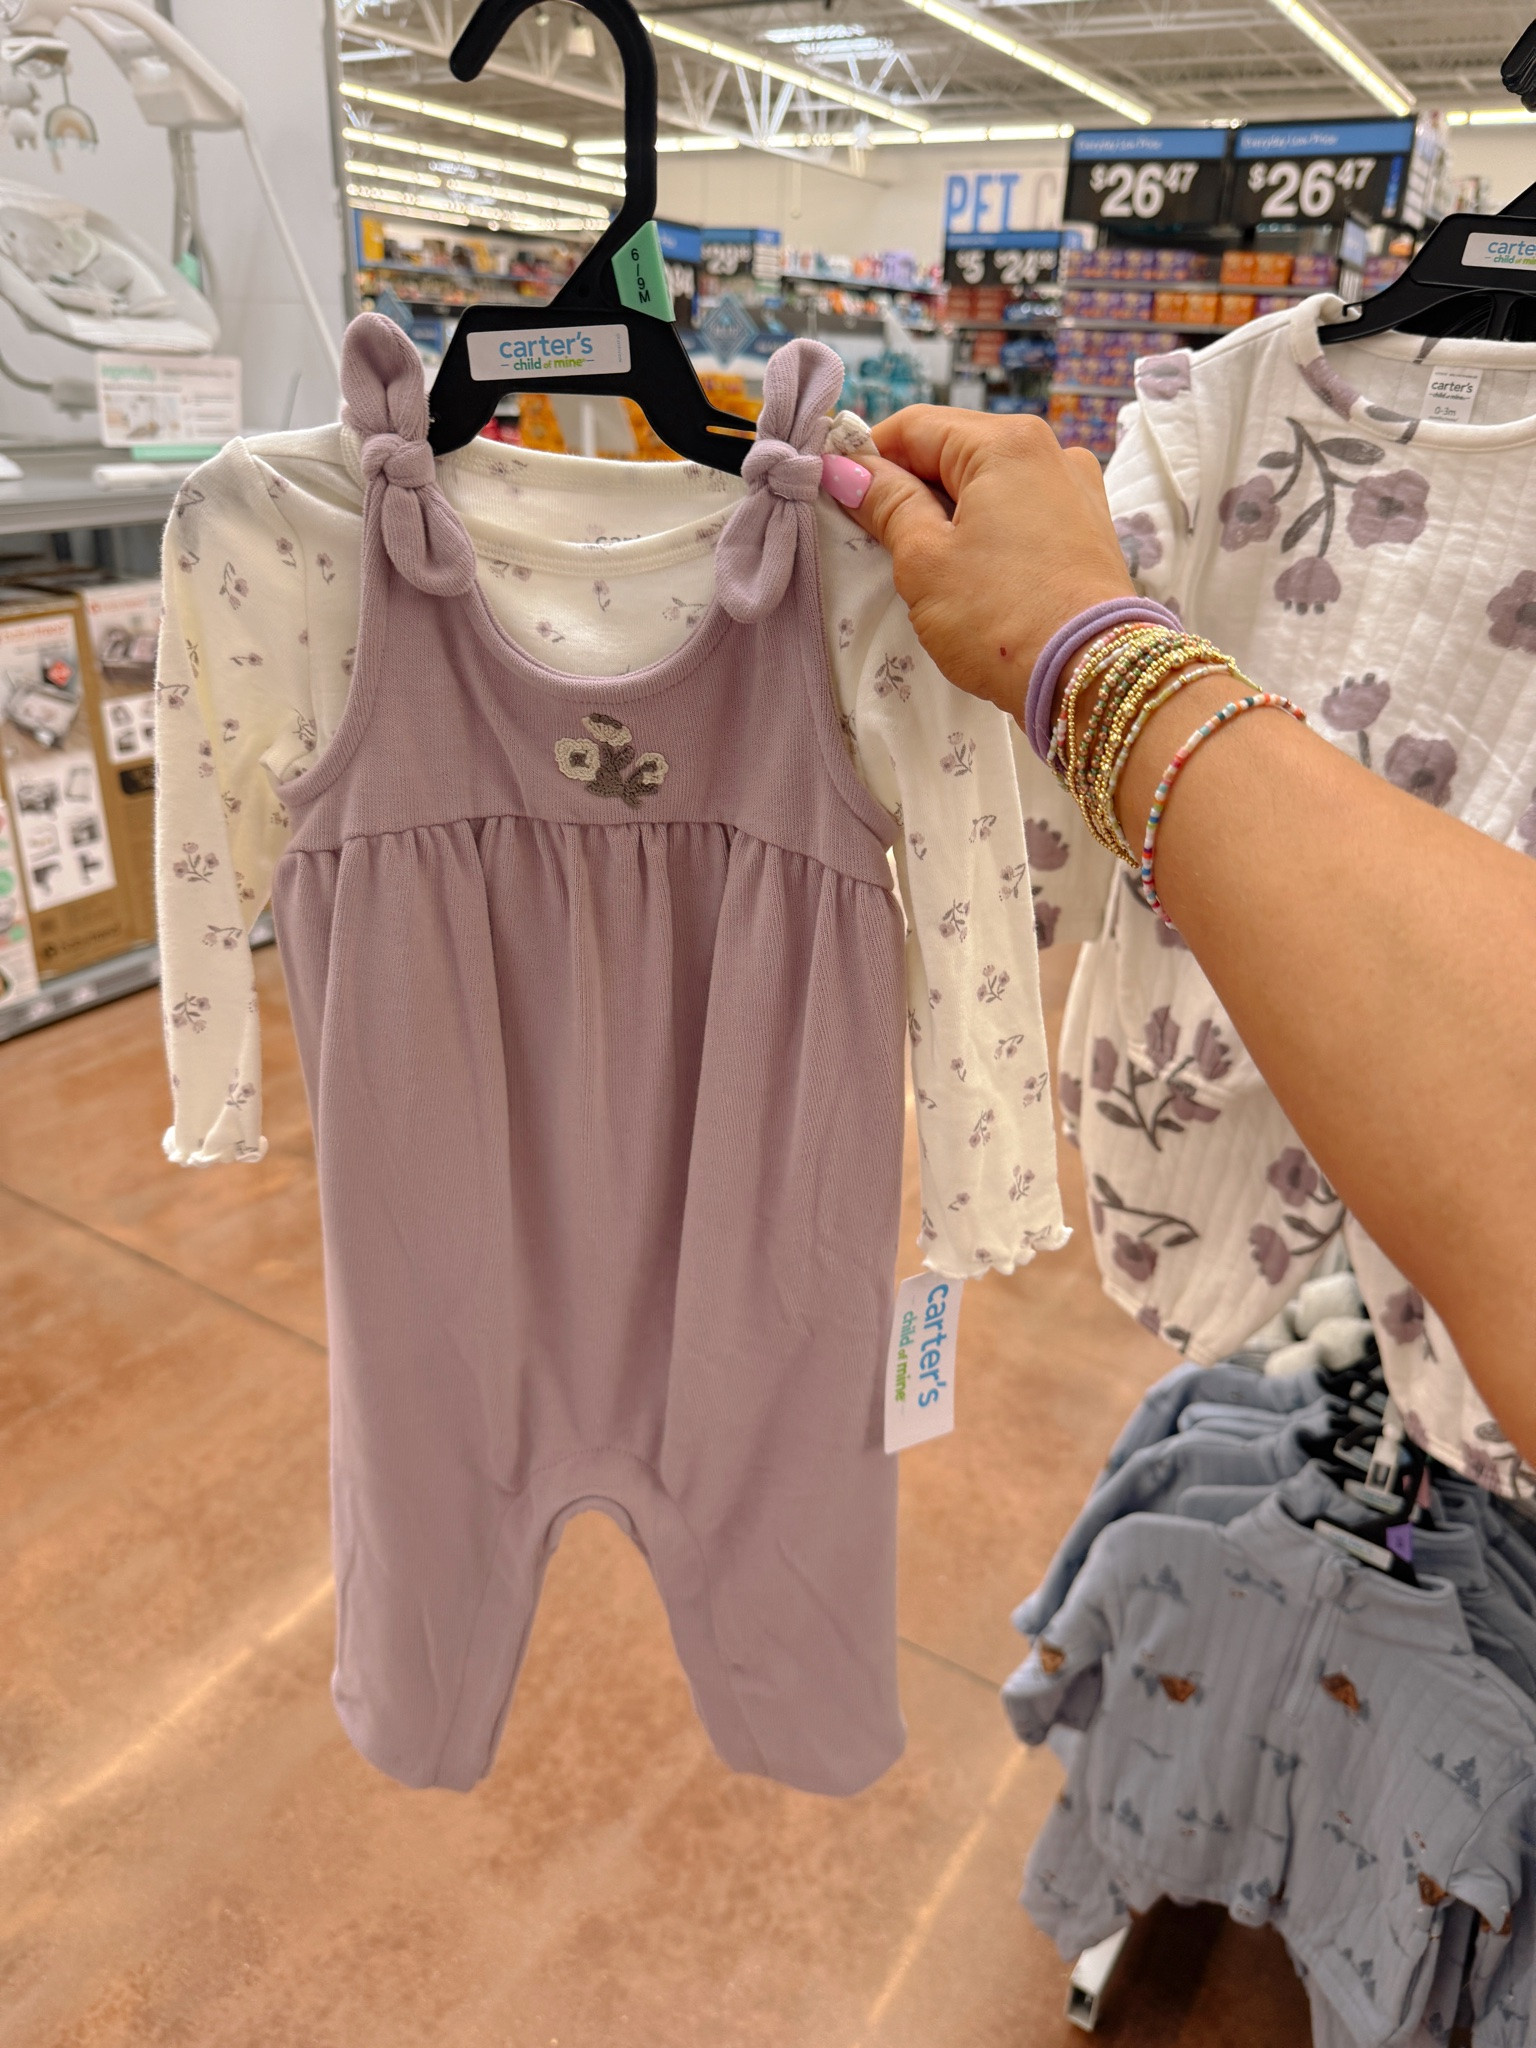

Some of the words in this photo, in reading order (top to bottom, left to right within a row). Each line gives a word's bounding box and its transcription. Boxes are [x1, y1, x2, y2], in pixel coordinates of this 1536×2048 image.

[499, 331, 593, 359] carter's
[513, 357, 542, 371] child
[543, 360, 552, 369] of
[553, 356, 584, 369] mine
[1431, 380, 1474, 394] carter's
[898, 1310, 918, 1347] child
[897, 1348, 908, 1360] of
[917, 1283, 950, 1408] carter's
[895, 1361, 911, 1402] mine
